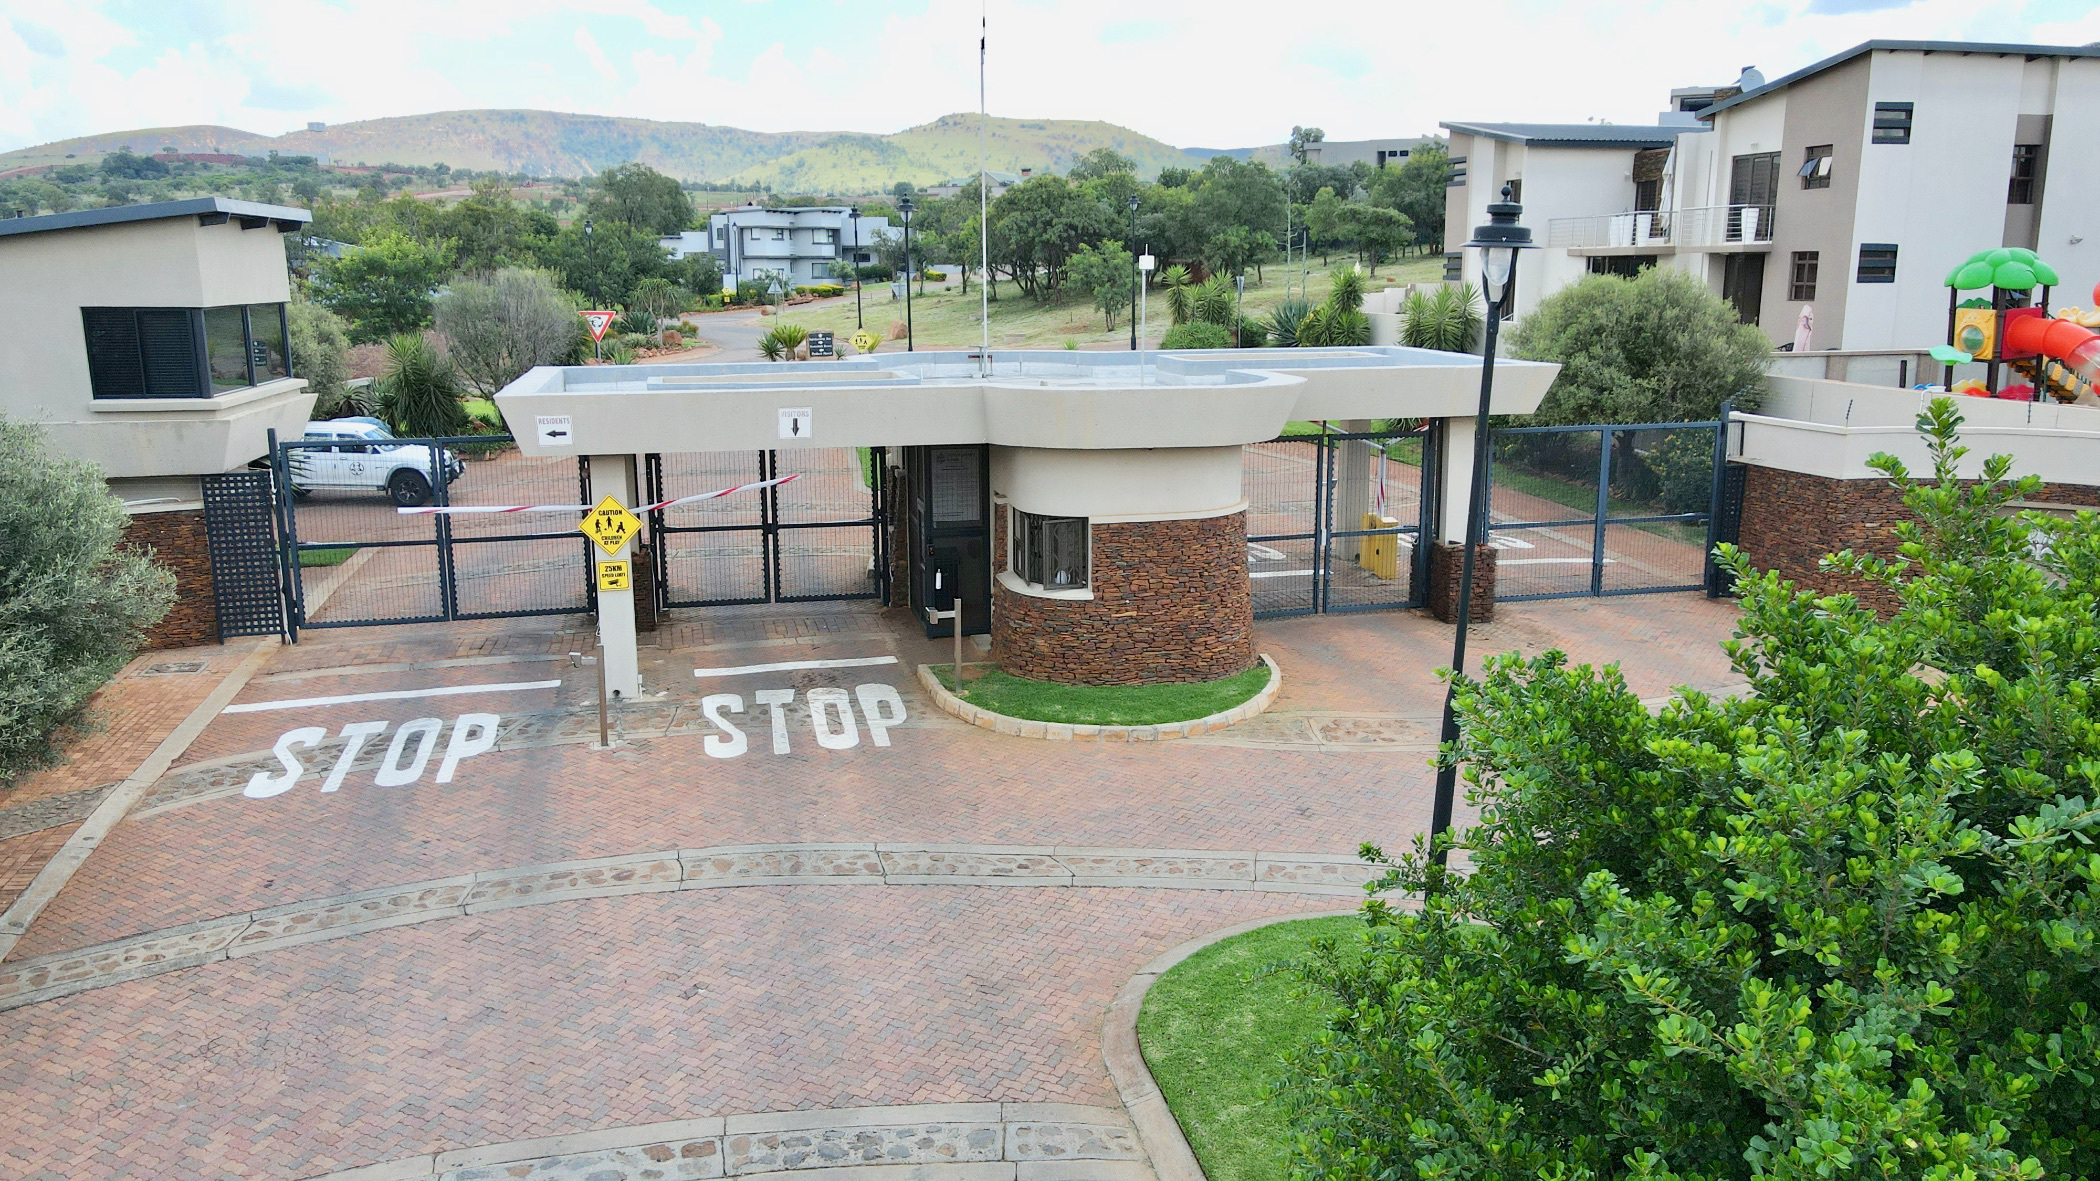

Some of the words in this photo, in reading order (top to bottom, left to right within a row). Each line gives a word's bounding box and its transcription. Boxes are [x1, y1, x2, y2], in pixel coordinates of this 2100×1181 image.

[538, 417, 570, 425] RESIDENTS
[781, 410, 809, 418] VISITORS
[700, 683, 908, 759] STOP
[243, 712, 500, 799] STOP
